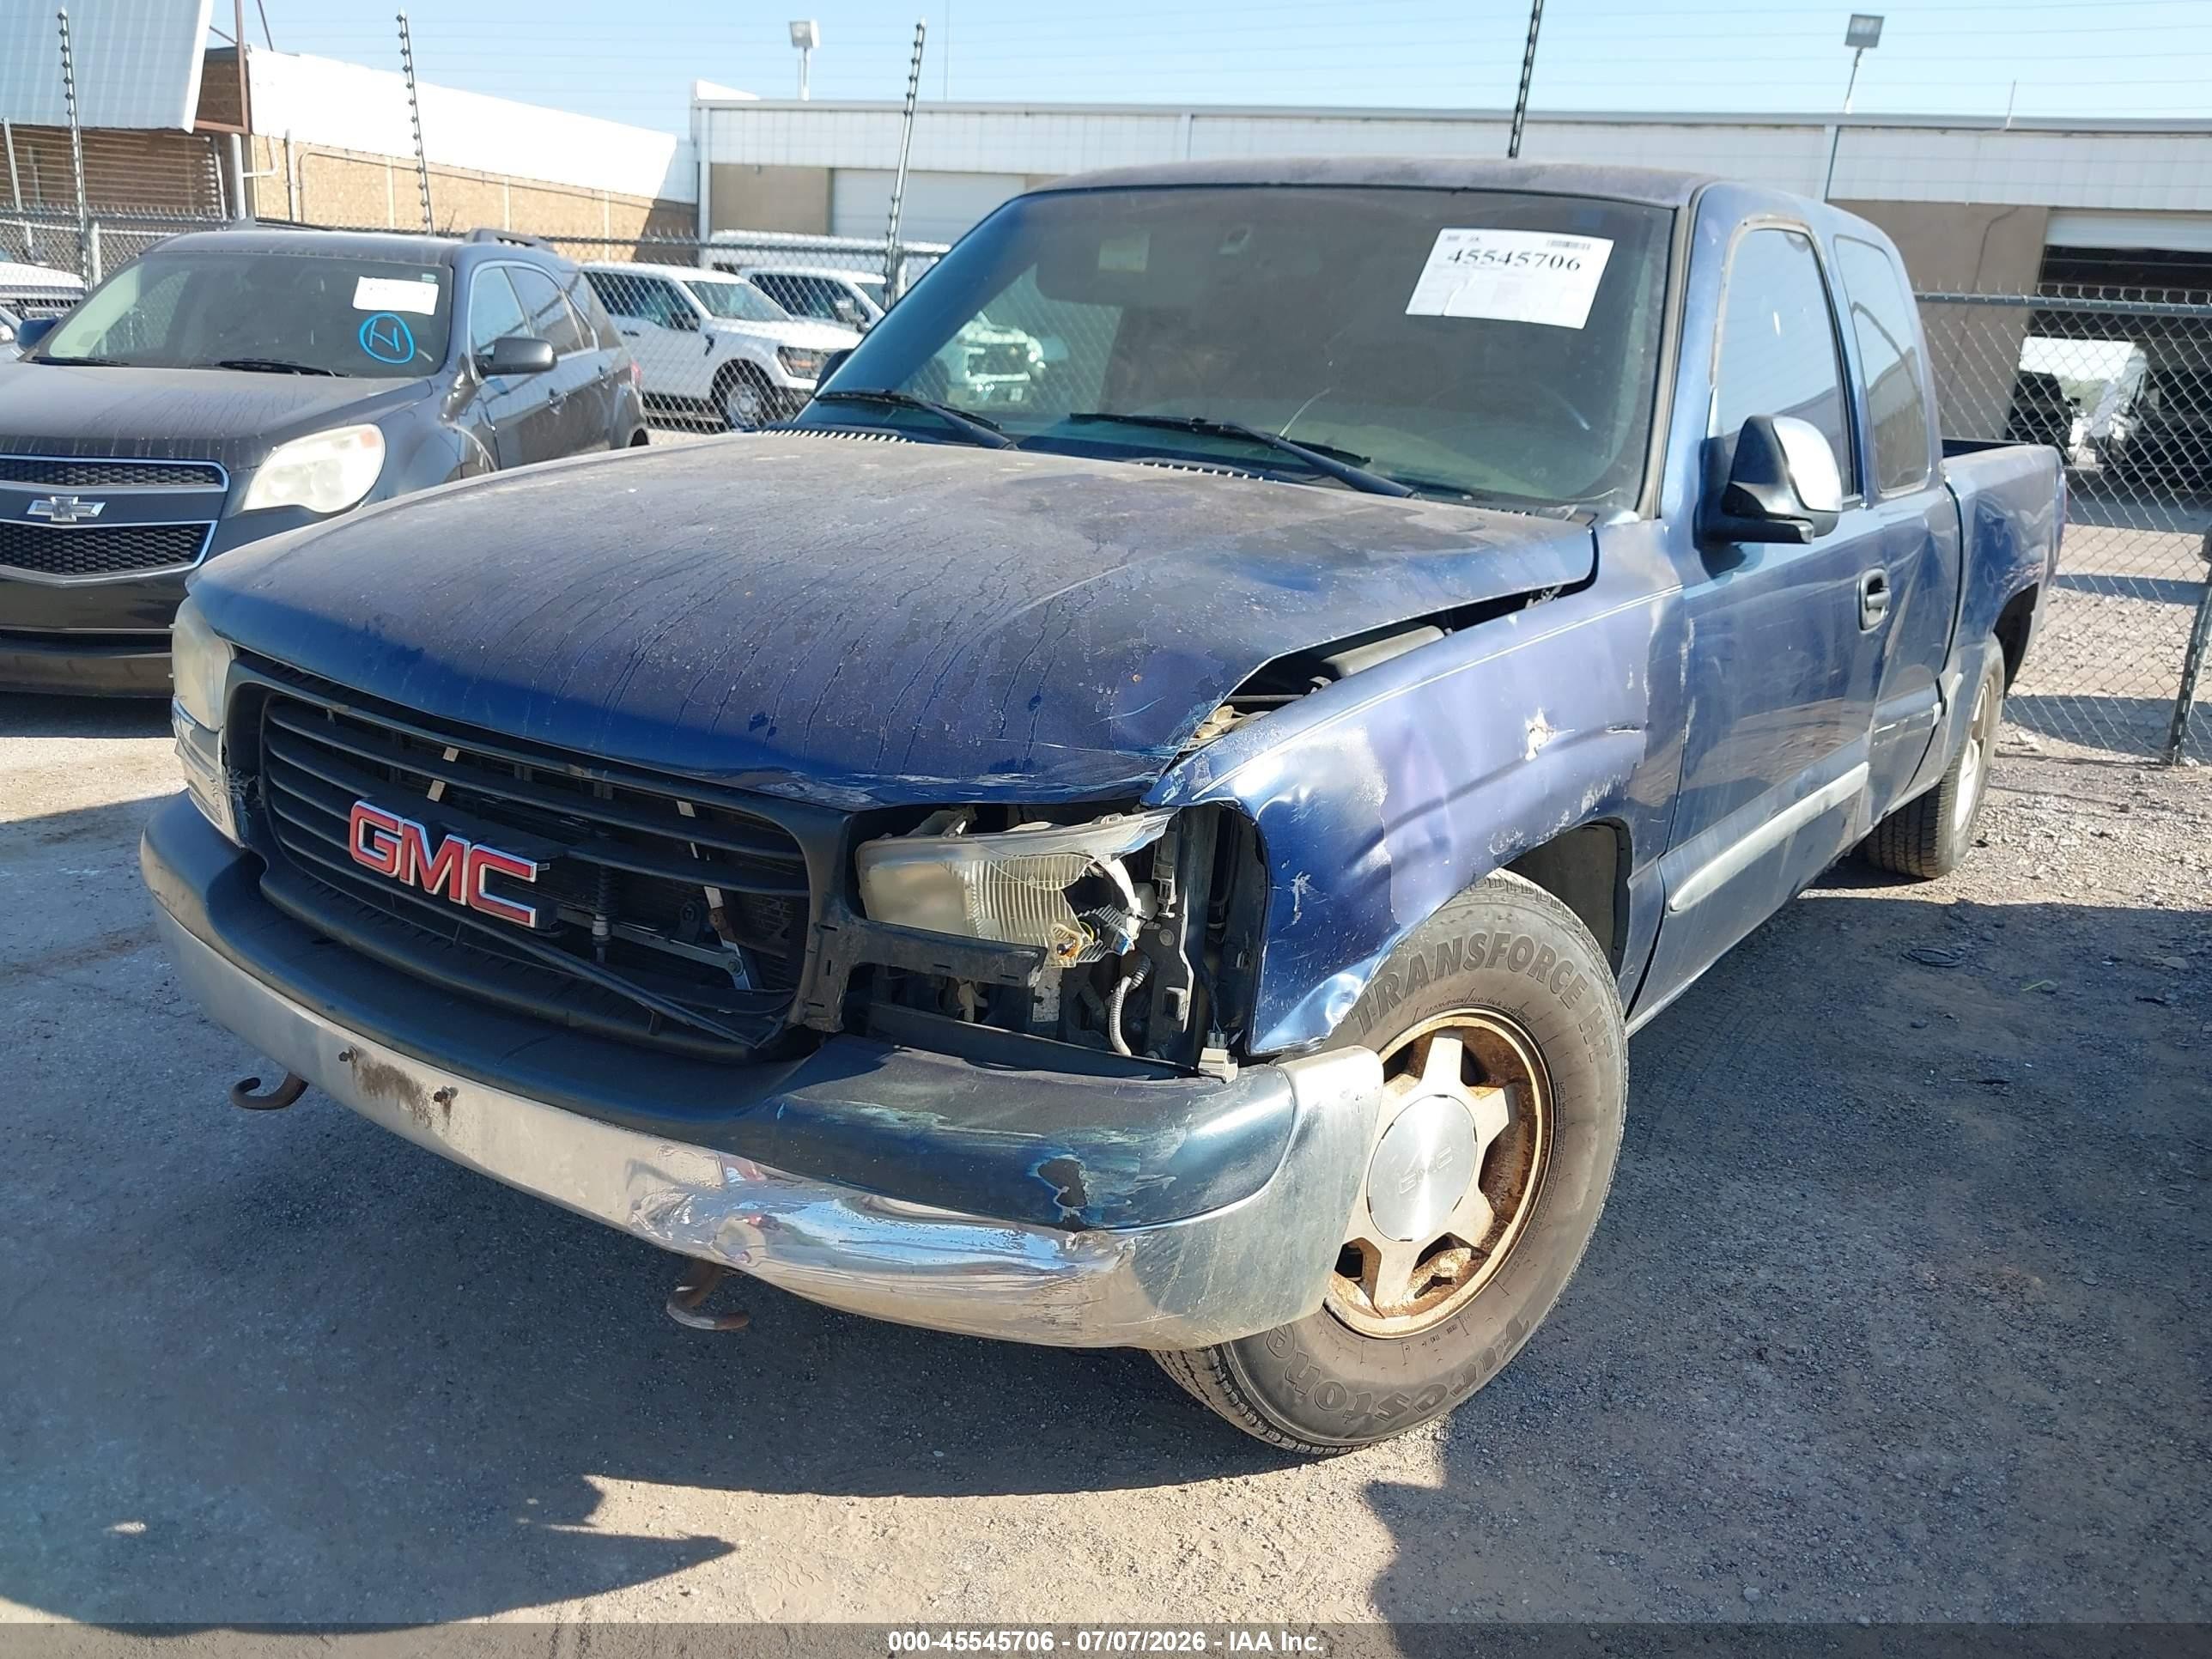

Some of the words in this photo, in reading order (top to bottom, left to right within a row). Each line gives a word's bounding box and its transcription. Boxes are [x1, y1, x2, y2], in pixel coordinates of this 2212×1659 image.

[1447, 248, 1582, 272] 45545706
[349, 800, 538, 928] GMC
[1350, 932, 1589, 1036] TRANSFORCE
[1265, 1316, 1530, 1425] Firestone
